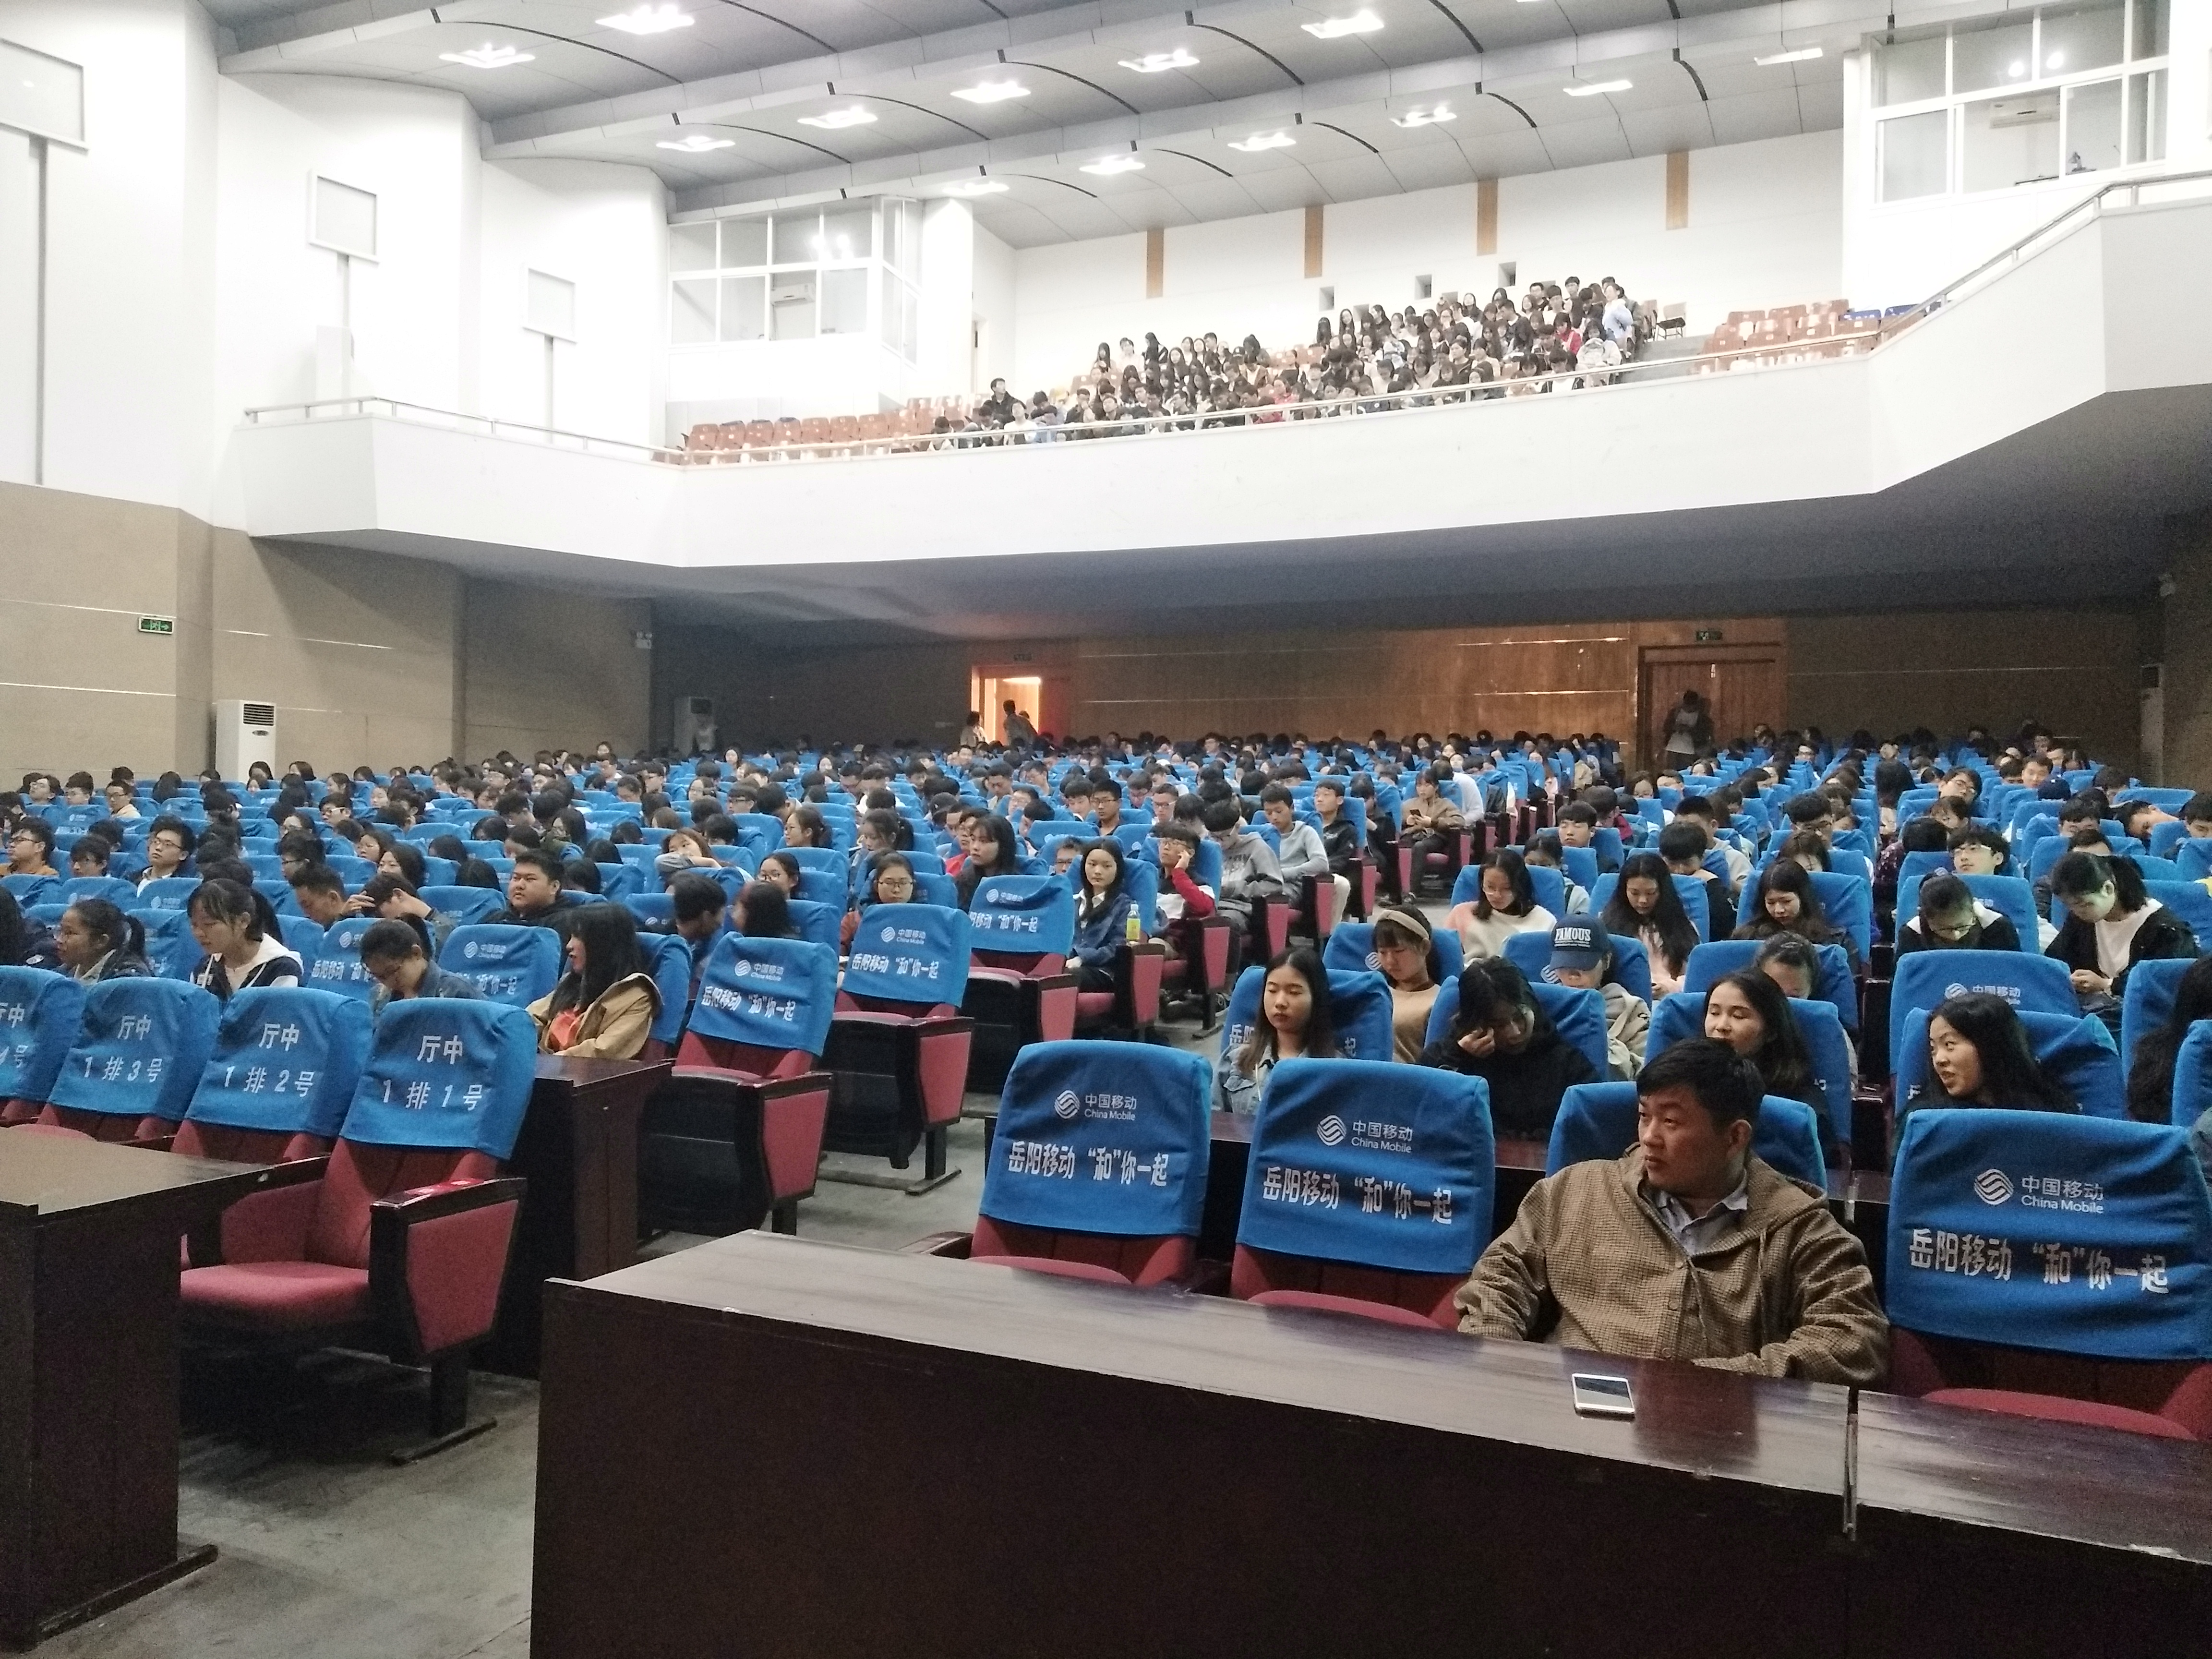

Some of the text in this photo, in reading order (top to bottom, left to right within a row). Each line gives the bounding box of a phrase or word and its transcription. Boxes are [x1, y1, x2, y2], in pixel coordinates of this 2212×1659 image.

[1554, 927, 1591, 941] FAMOUS
[118, 1014, 152, 1040] 厅中
[259, 1023, 300, 1051] 厅中
[417, 1035, 463, 1064] 厅中
[1084, 1108, 1136, 1121] China Mobile
[1085, 1094, 1137, 1109] 中国移动
[1352, 1120, 1413, 1142] 中国移动
[1351, 1137, 1411, 1153] China Mobile
[1008, 1141, 1075, 1179] 岳阳移动
[1263, 1166, 1339, 1209] 岳阳移动
[2021, 1175, 2104, 1201] 中国移动
[2021, 1195, 2104, 1214] China Mobile
[1910, 1228, 2012, 1281] 岳阳移动
